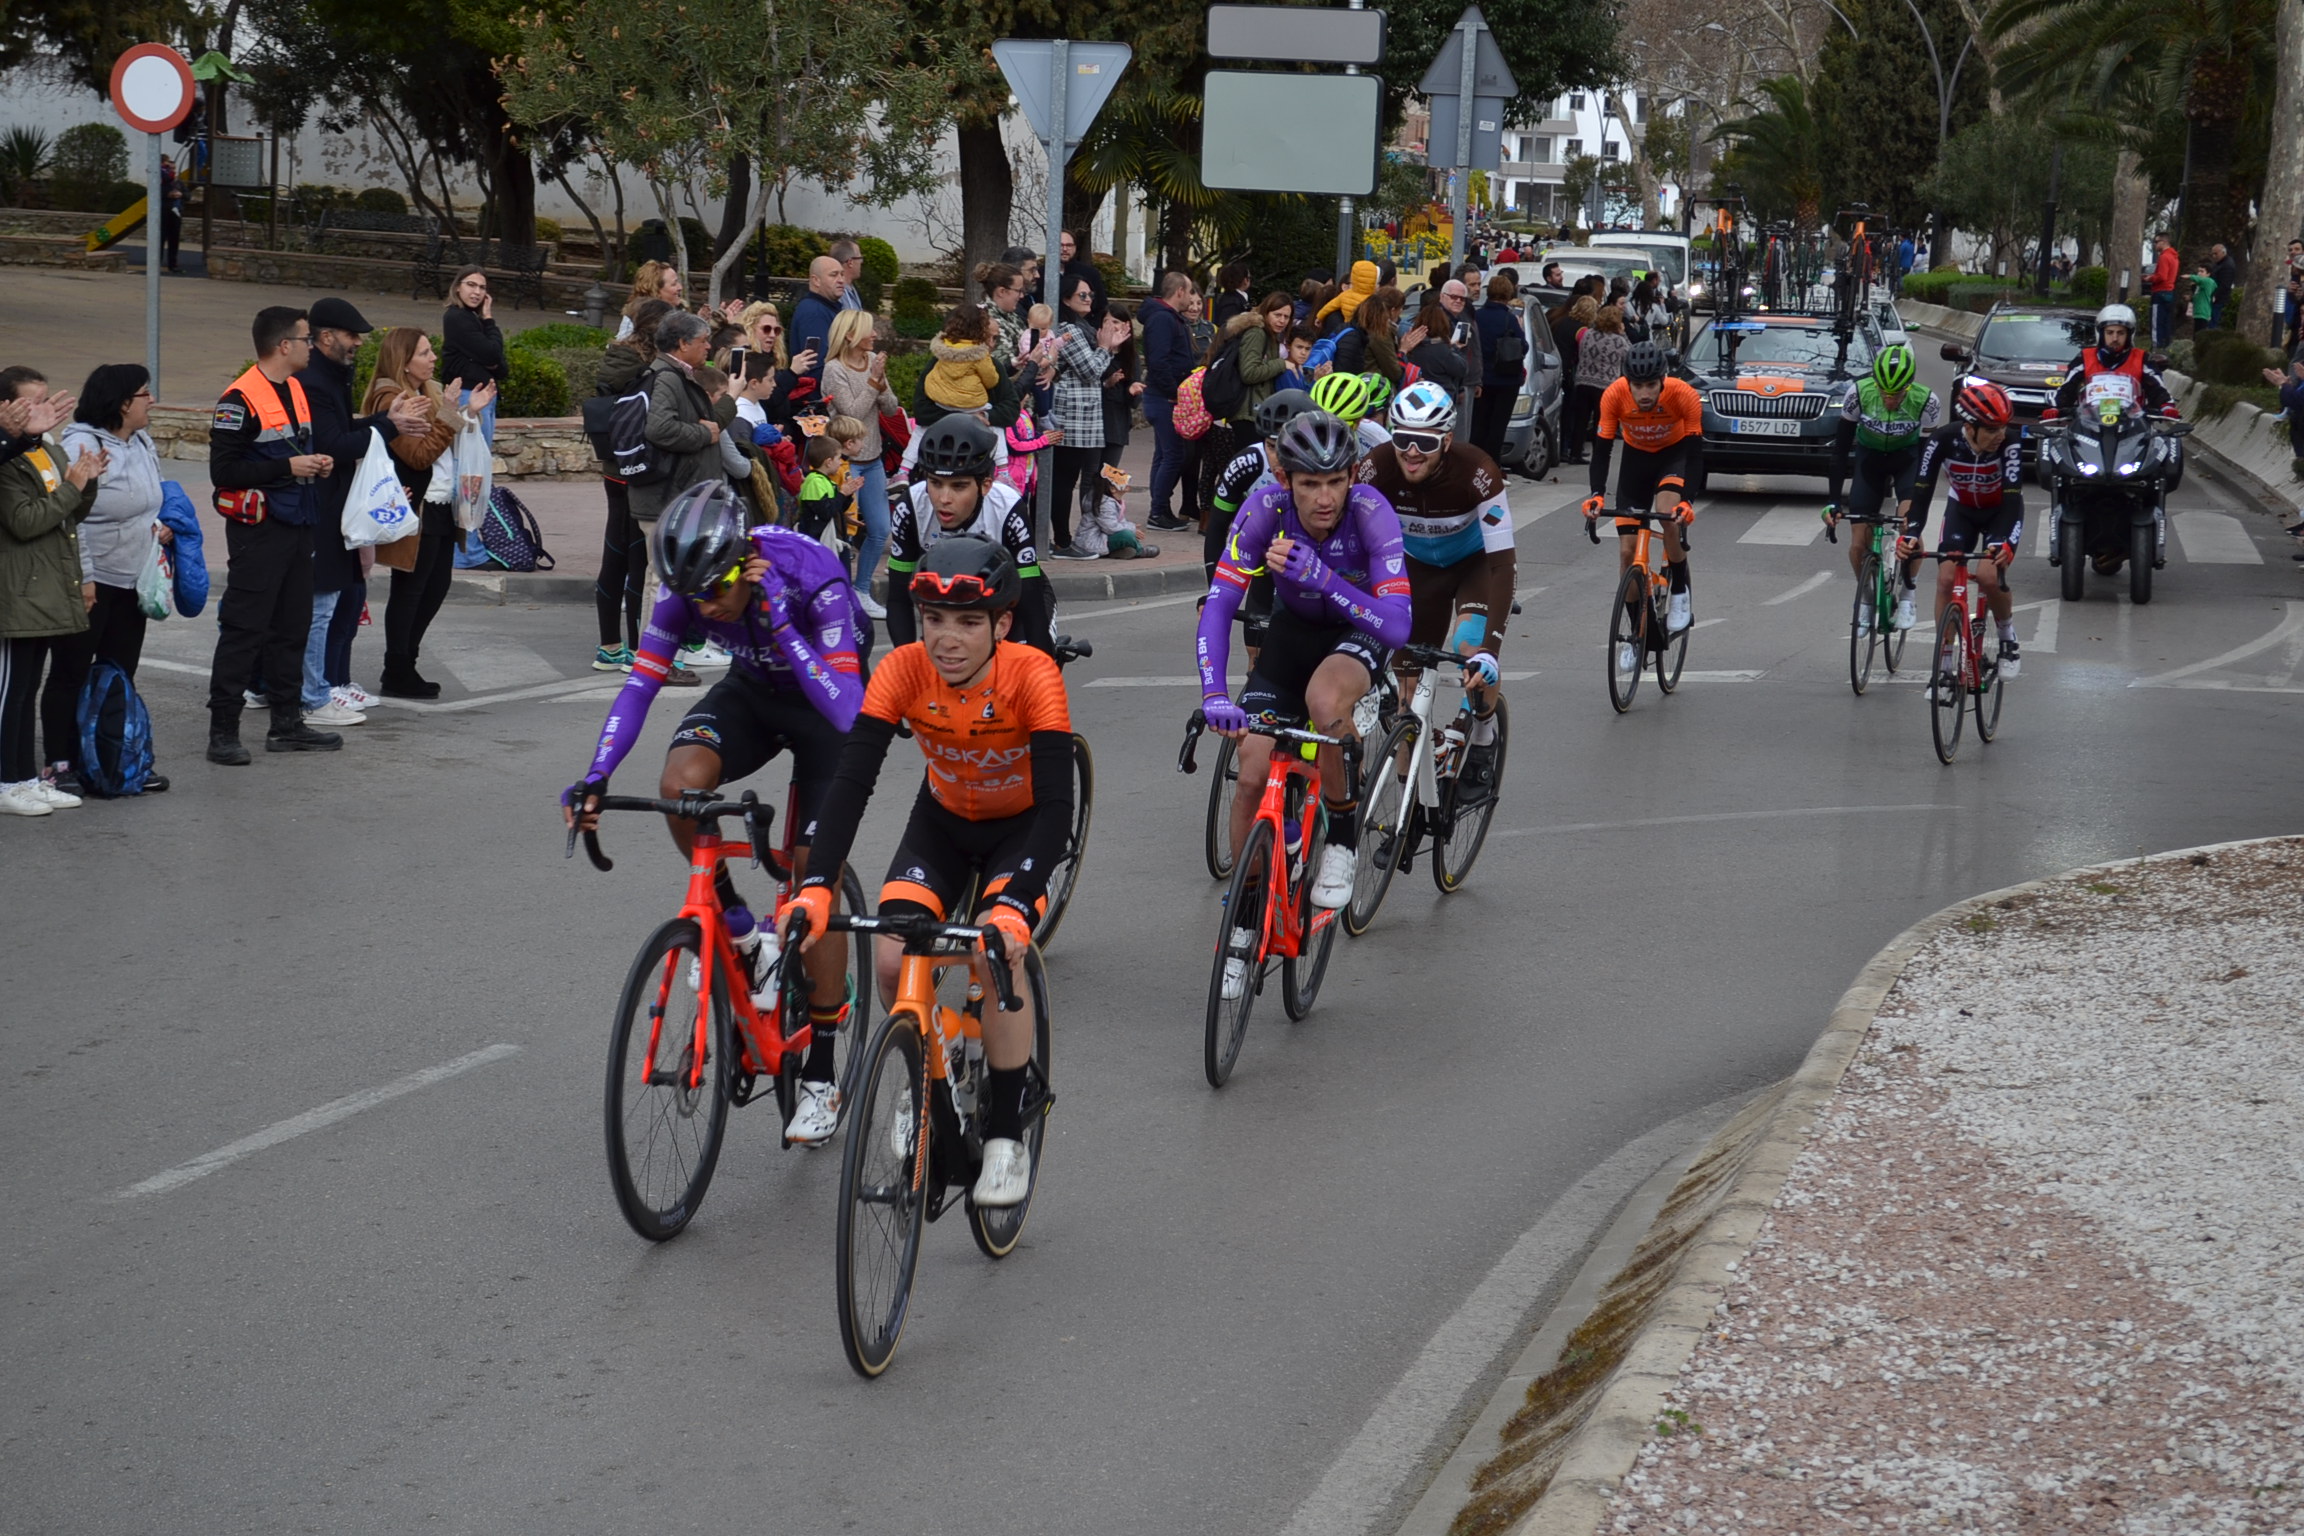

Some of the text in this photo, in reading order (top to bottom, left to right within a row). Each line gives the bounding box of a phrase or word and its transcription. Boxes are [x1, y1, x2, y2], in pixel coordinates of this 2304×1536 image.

[1740, 420, 1798, 435] 6577 LDZ
[1919, 440, 1940, 477] SOUDAL
[2042, 438, 2050, 461] KEN
[619, 462, 647, 476] adidas
[1223, 452, 1258, 482] KERN
[890, 501, 911, 537] KER
[1330, 592, 1350, 608] BH
[790, 640, 811, 661] BH
[1198, 636, 1207, 655] BH
[1335, 642, 1378, 670] BH
[1266, 778, 1283, 789] BH
[690, 865, 713, 876] BH
